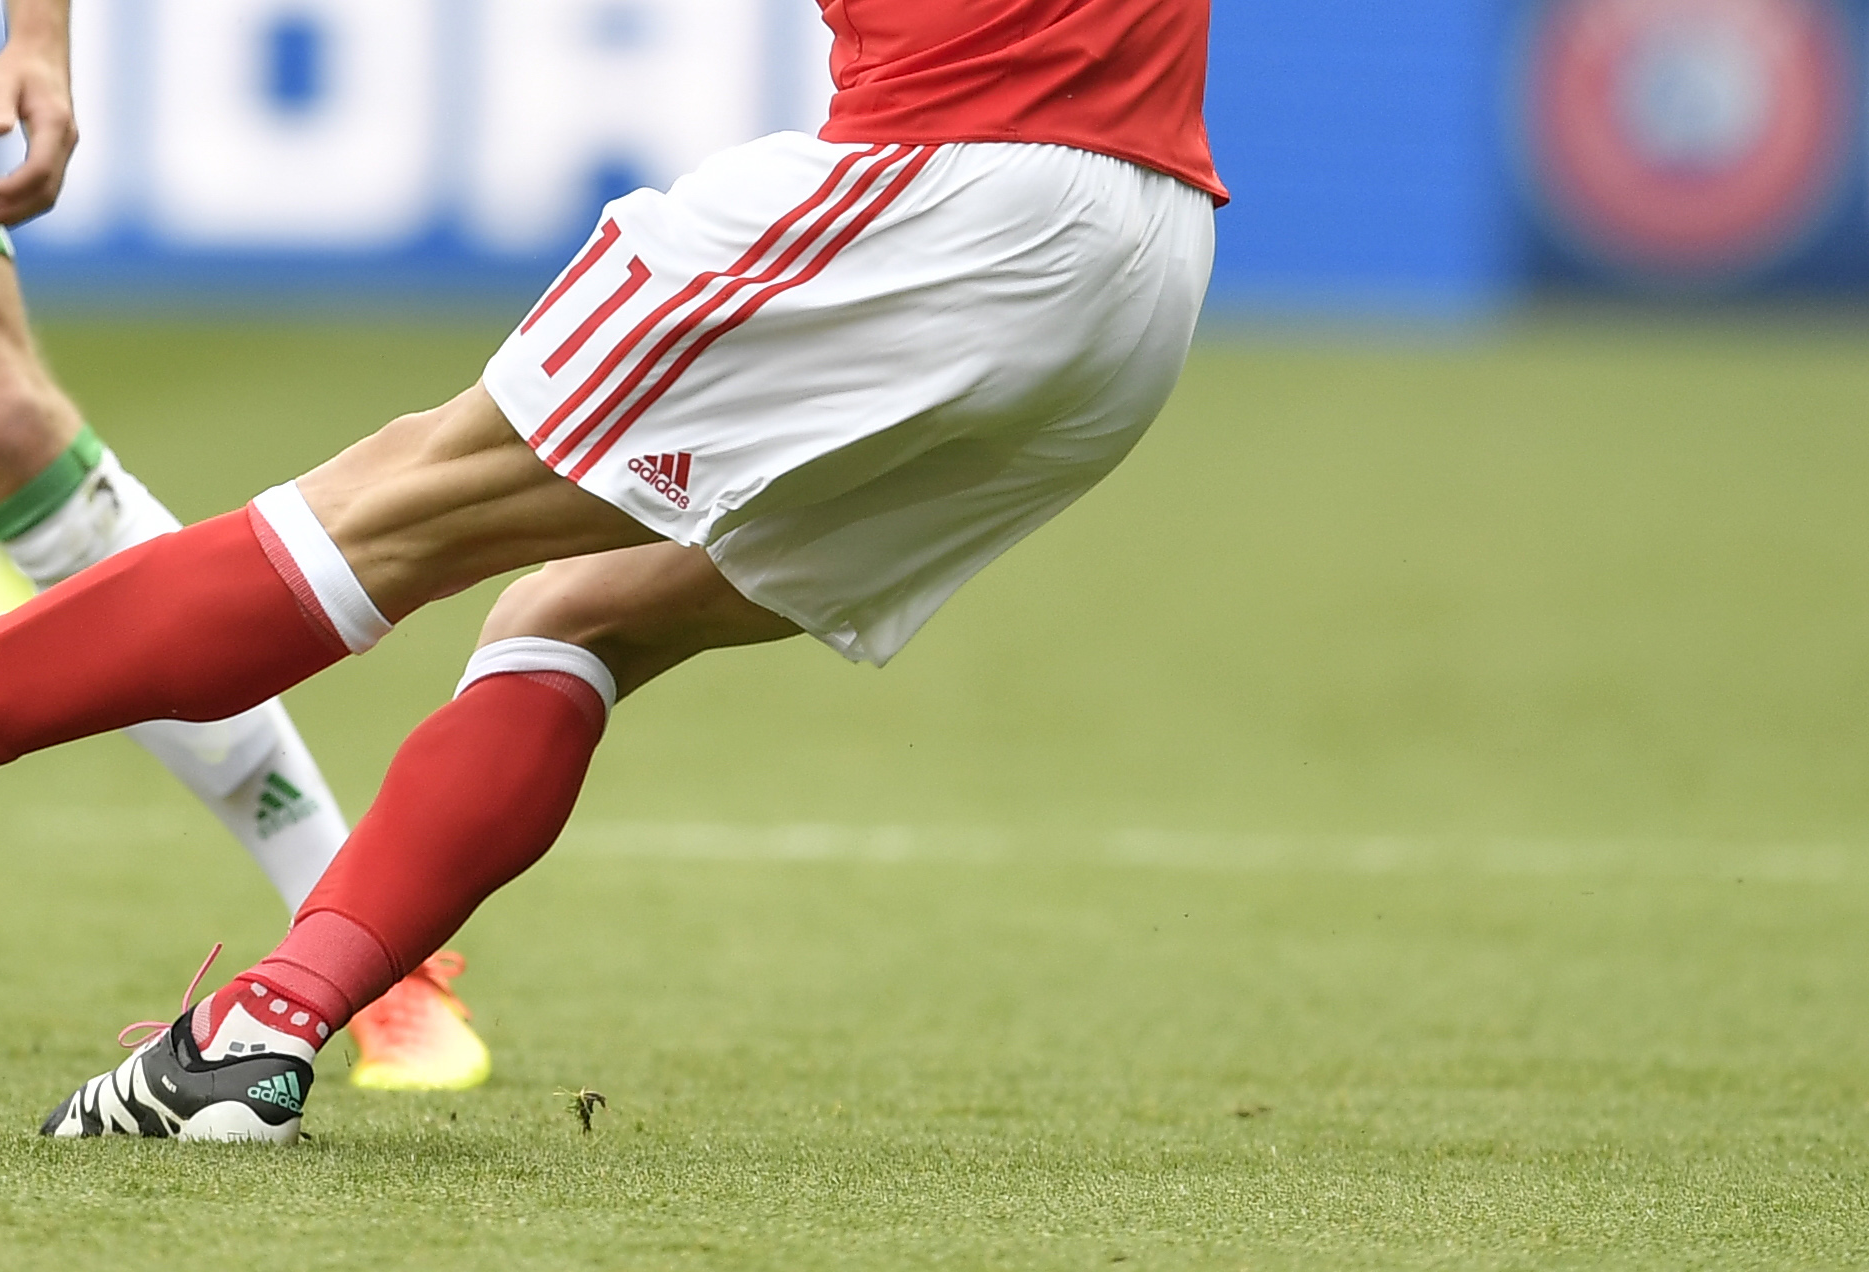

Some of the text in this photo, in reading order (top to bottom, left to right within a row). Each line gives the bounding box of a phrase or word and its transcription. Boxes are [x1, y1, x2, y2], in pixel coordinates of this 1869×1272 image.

[520, 217, 652, 379] 11
[627, 457, 690, 510] adidas
[247, 1086, 302, 1114] adida
